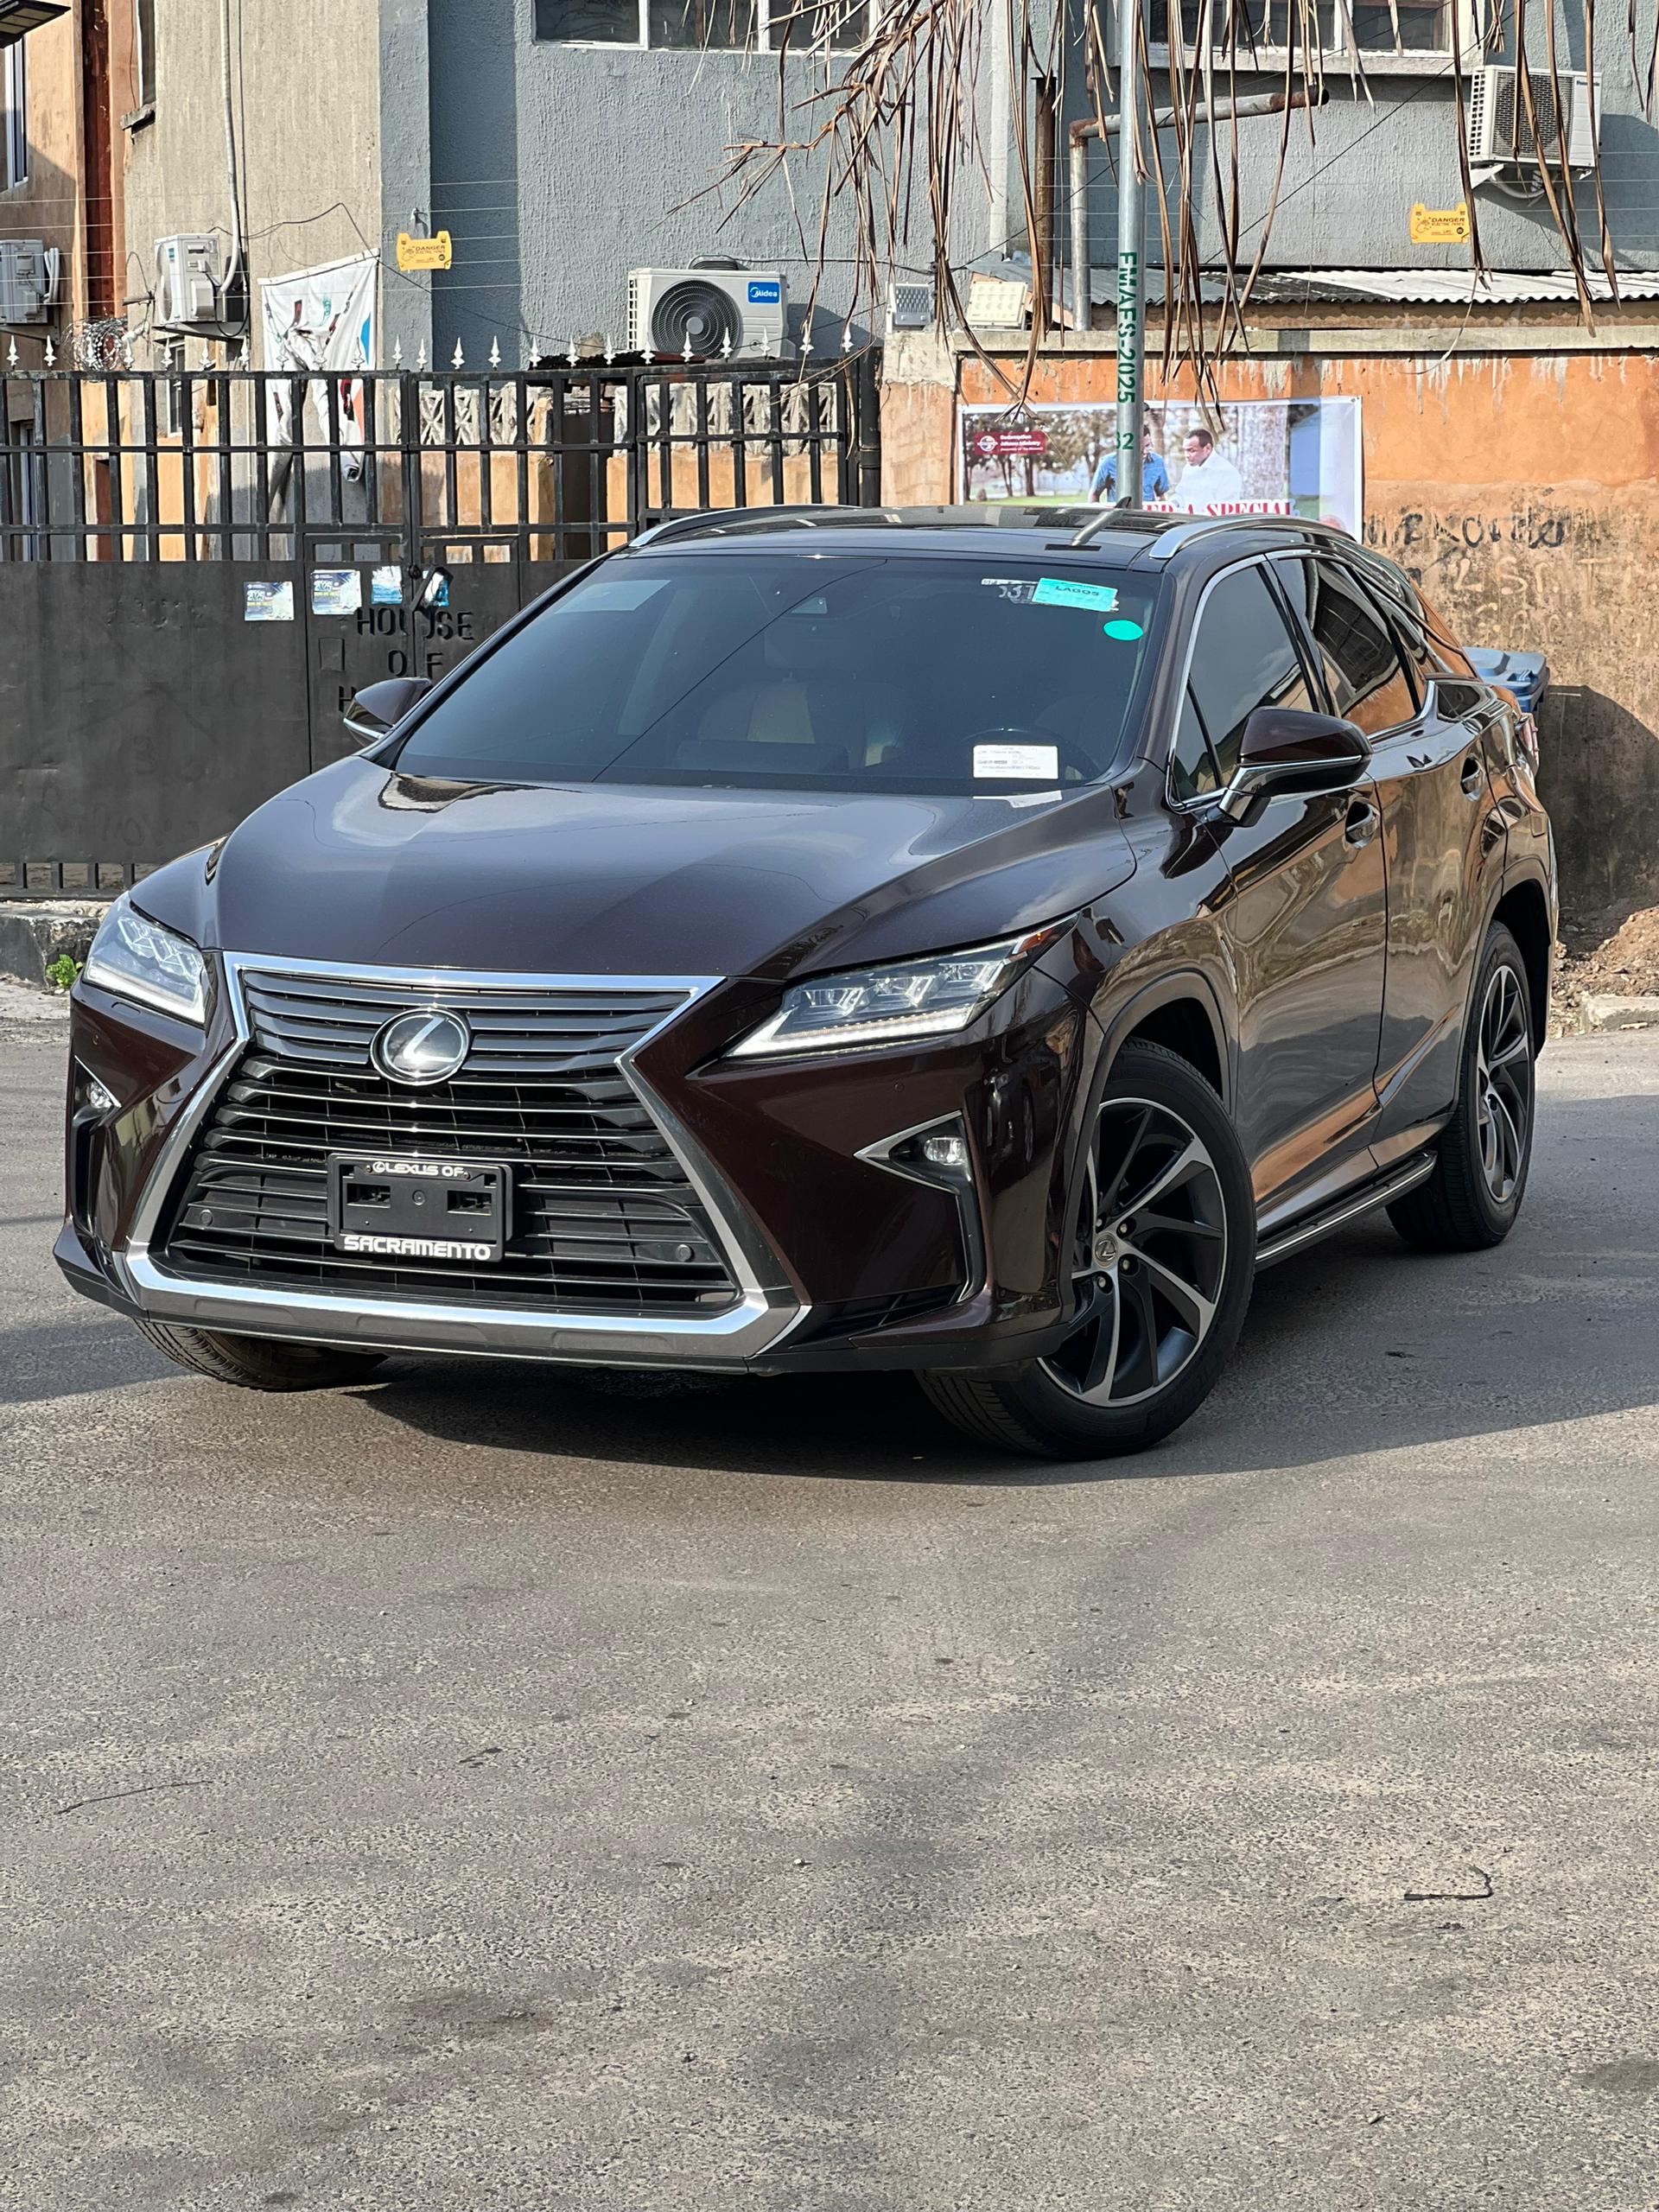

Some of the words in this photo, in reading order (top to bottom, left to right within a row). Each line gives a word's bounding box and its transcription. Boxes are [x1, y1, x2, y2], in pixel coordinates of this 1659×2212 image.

[749, 286, 778, 298] Midea
[1117, 251, 1137, 404] FMAFS-2025
[1055, 586, 1100, 596] LAGOS
[385, 1163, 439, 1176] LEXUS
[442, 1166, 465, 1178] OF
[344, 1236, 492, 1262] SACRAMENTO
